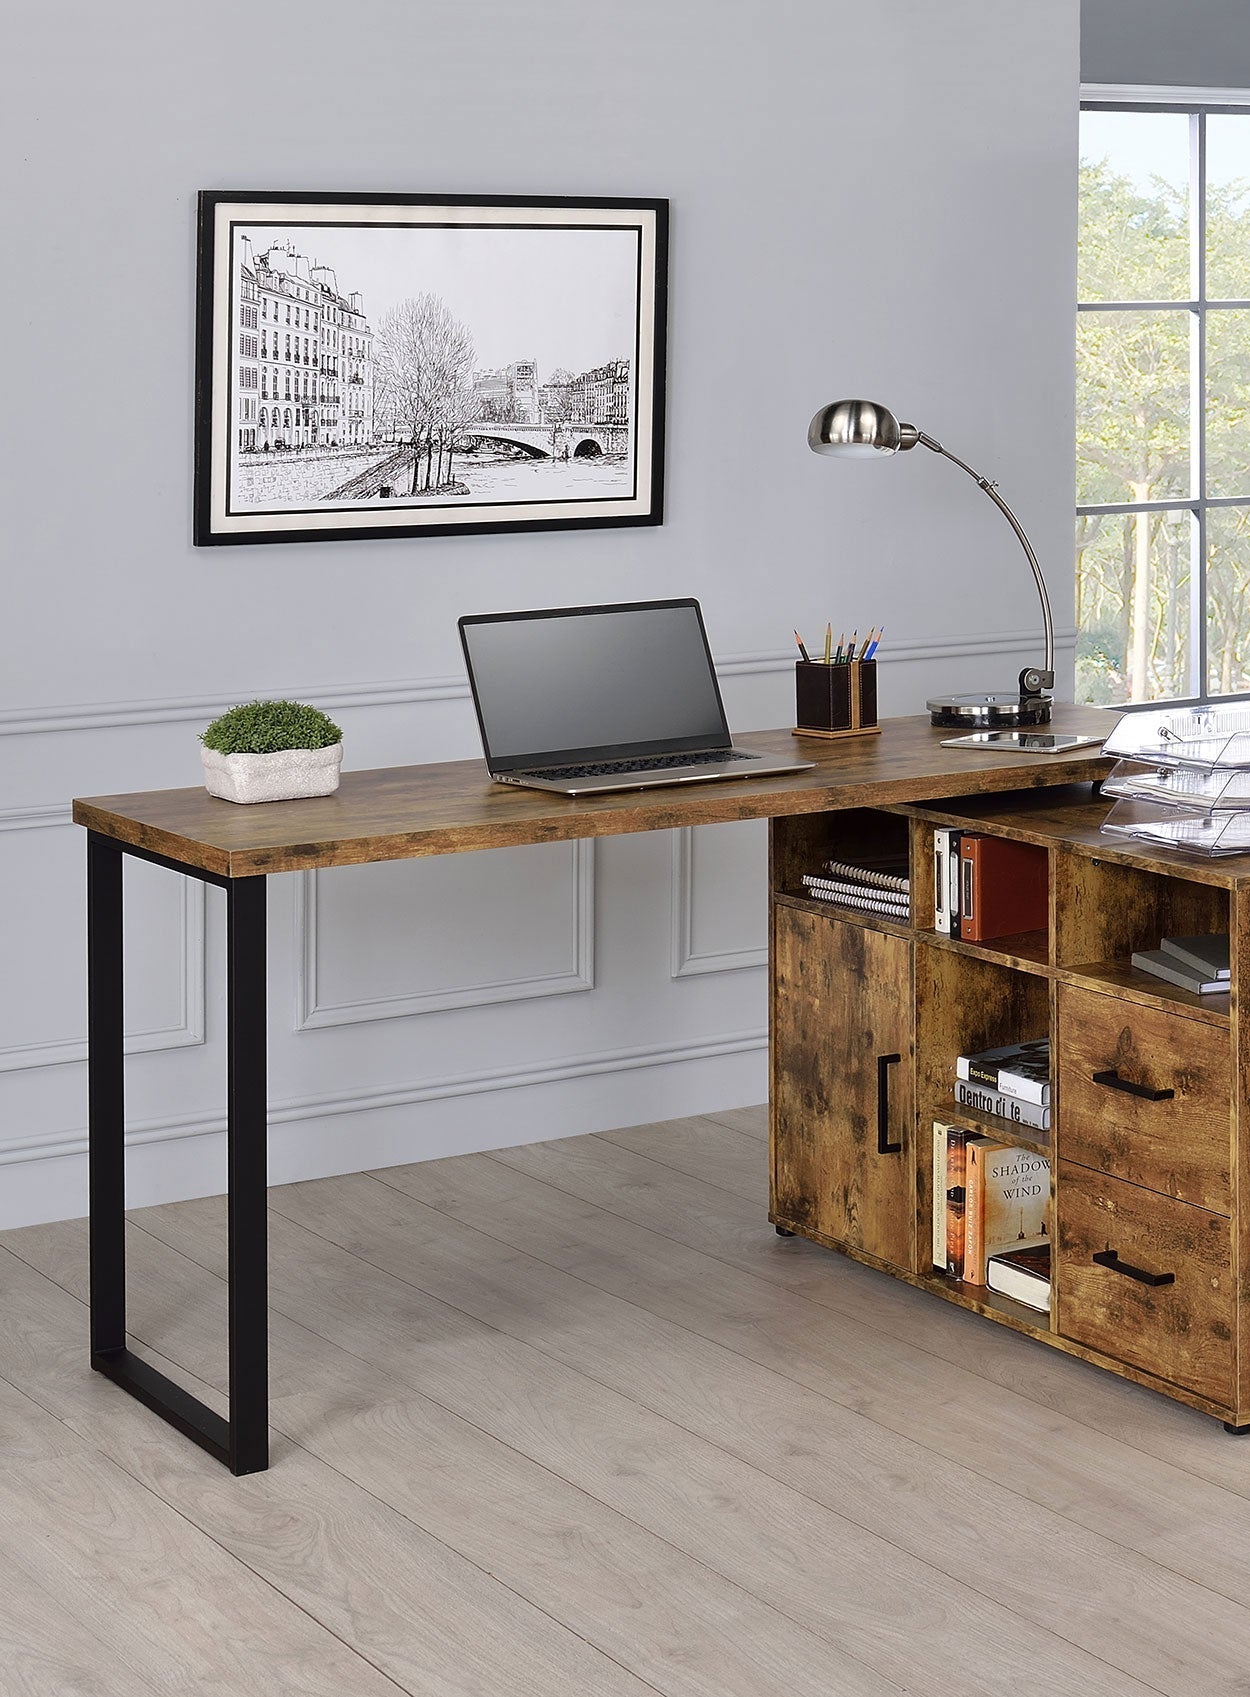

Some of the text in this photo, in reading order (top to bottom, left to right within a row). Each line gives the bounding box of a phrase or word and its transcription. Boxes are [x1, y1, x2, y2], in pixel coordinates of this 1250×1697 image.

[970, 1067, 997, 1083] Expo Express
[959, 1084, 1021, 1122] Dentro di te
[1016, 1154, 1030, 1162] The
[992, 1159, 1050, 1178] SHADOW
[1011, 1174, 1033, 1186] of the
[1003, 1184, 1041, 1199] WIND
